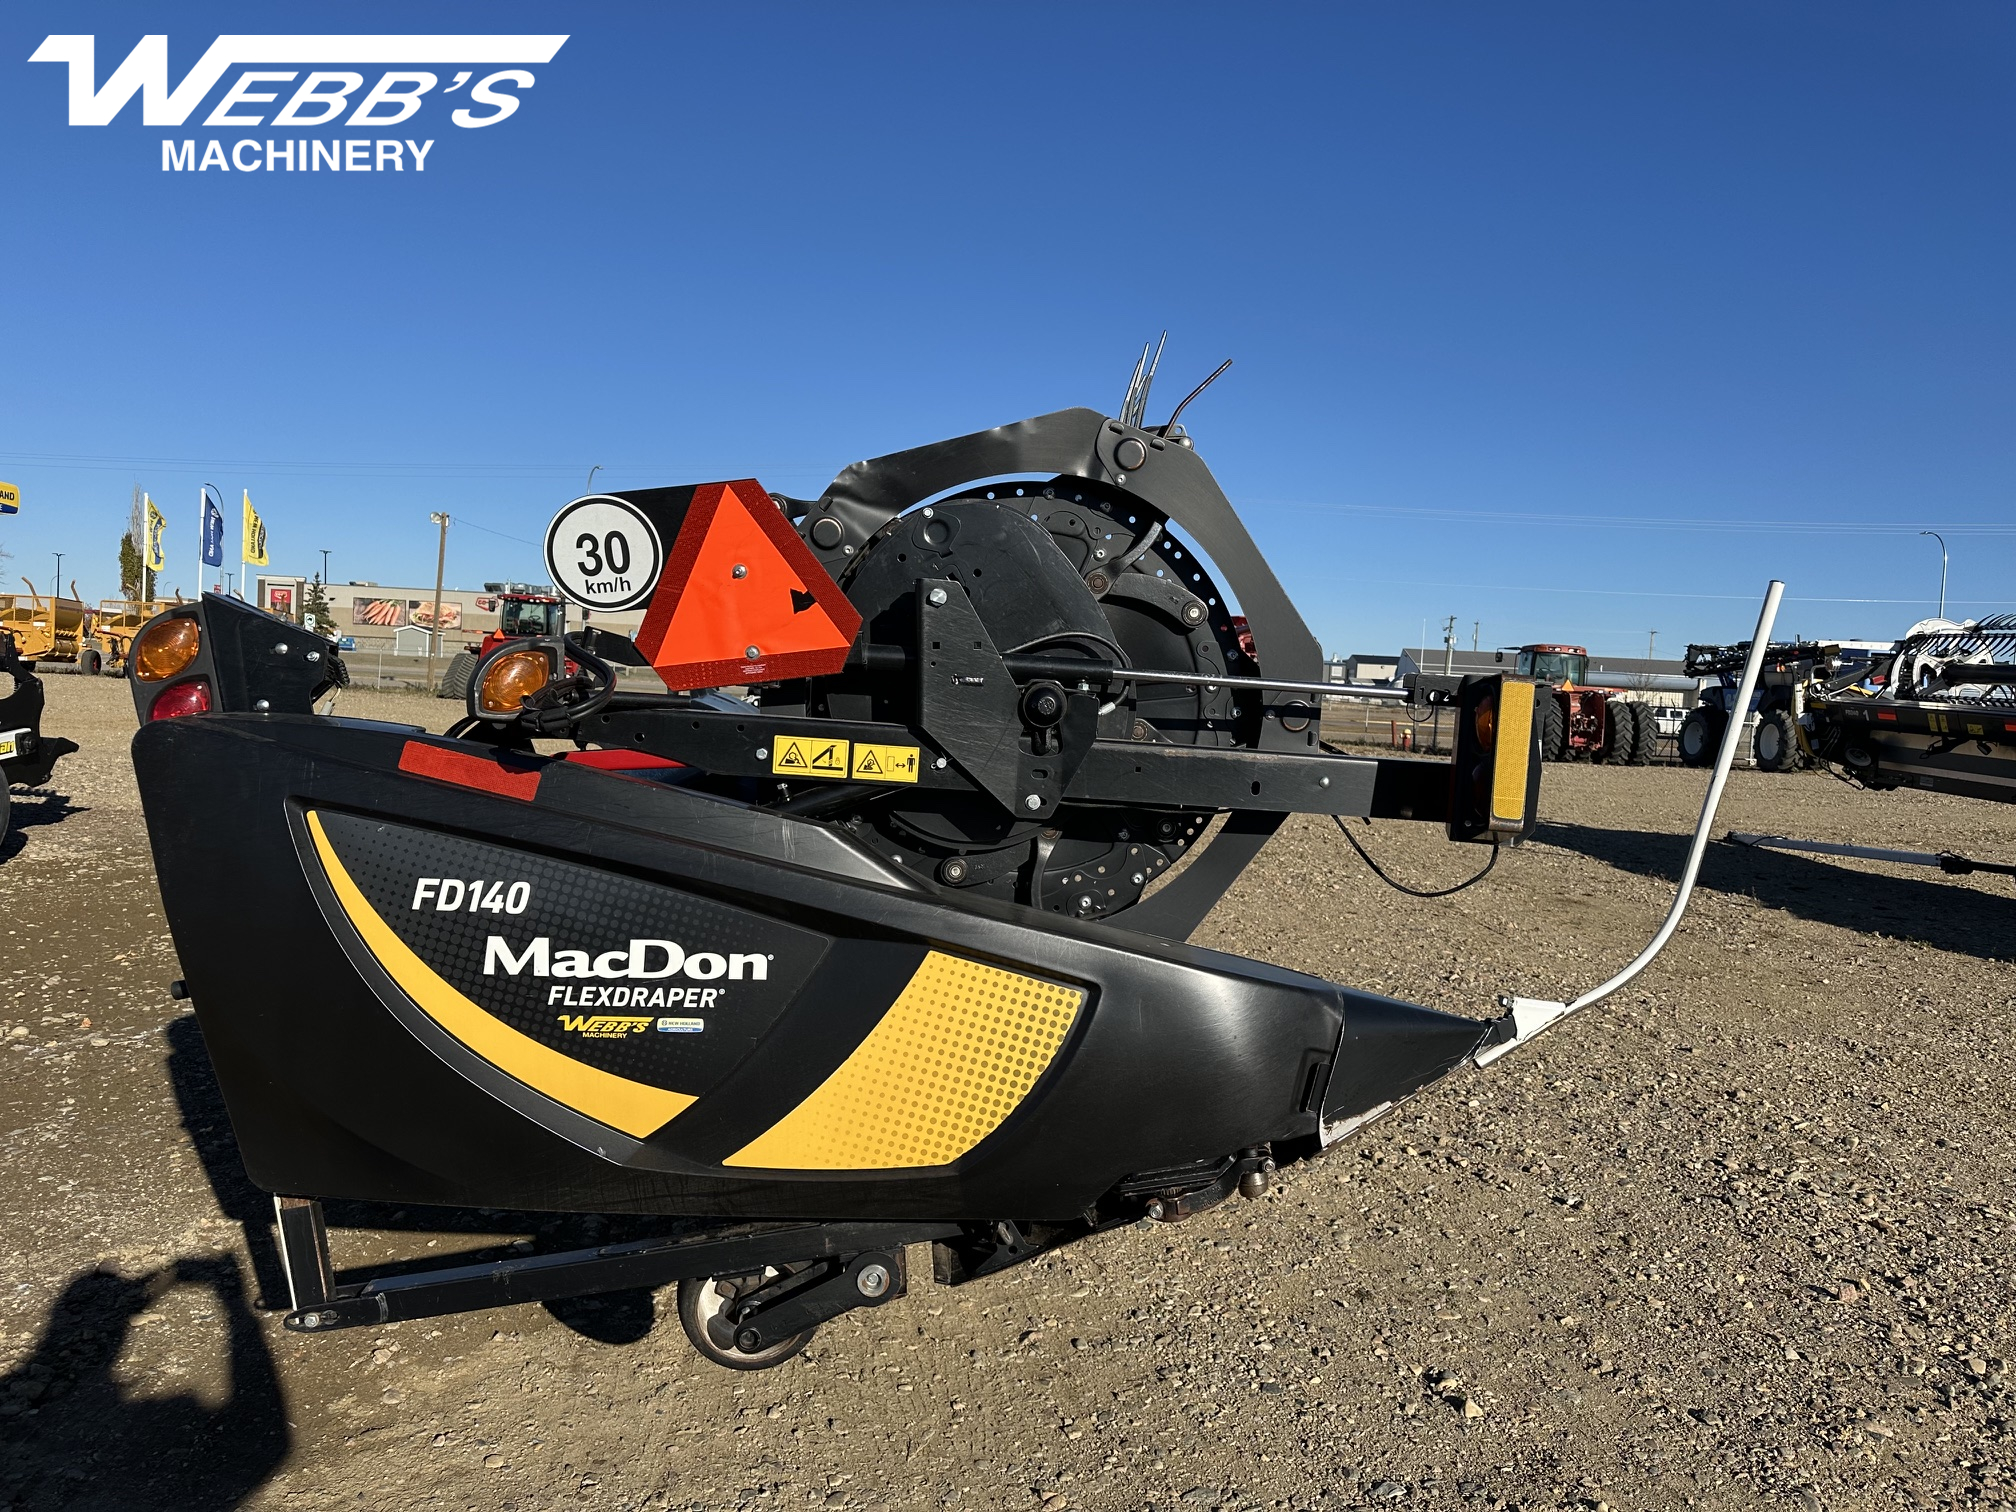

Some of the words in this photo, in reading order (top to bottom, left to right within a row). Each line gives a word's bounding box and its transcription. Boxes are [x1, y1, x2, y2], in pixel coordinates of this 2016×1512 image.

[576, 530, 630, 577] 30
[584, 576, 632, 594] km/h
[411, 877, 531, 915] FD140
[483, 935, 770, 981] MacDon
[547, 985, 718, 1008] FLEXDRAPER
[557, 1015, 655, 1033] WEBB'S
[582, 1031, 628, 1039] MACHINERY
